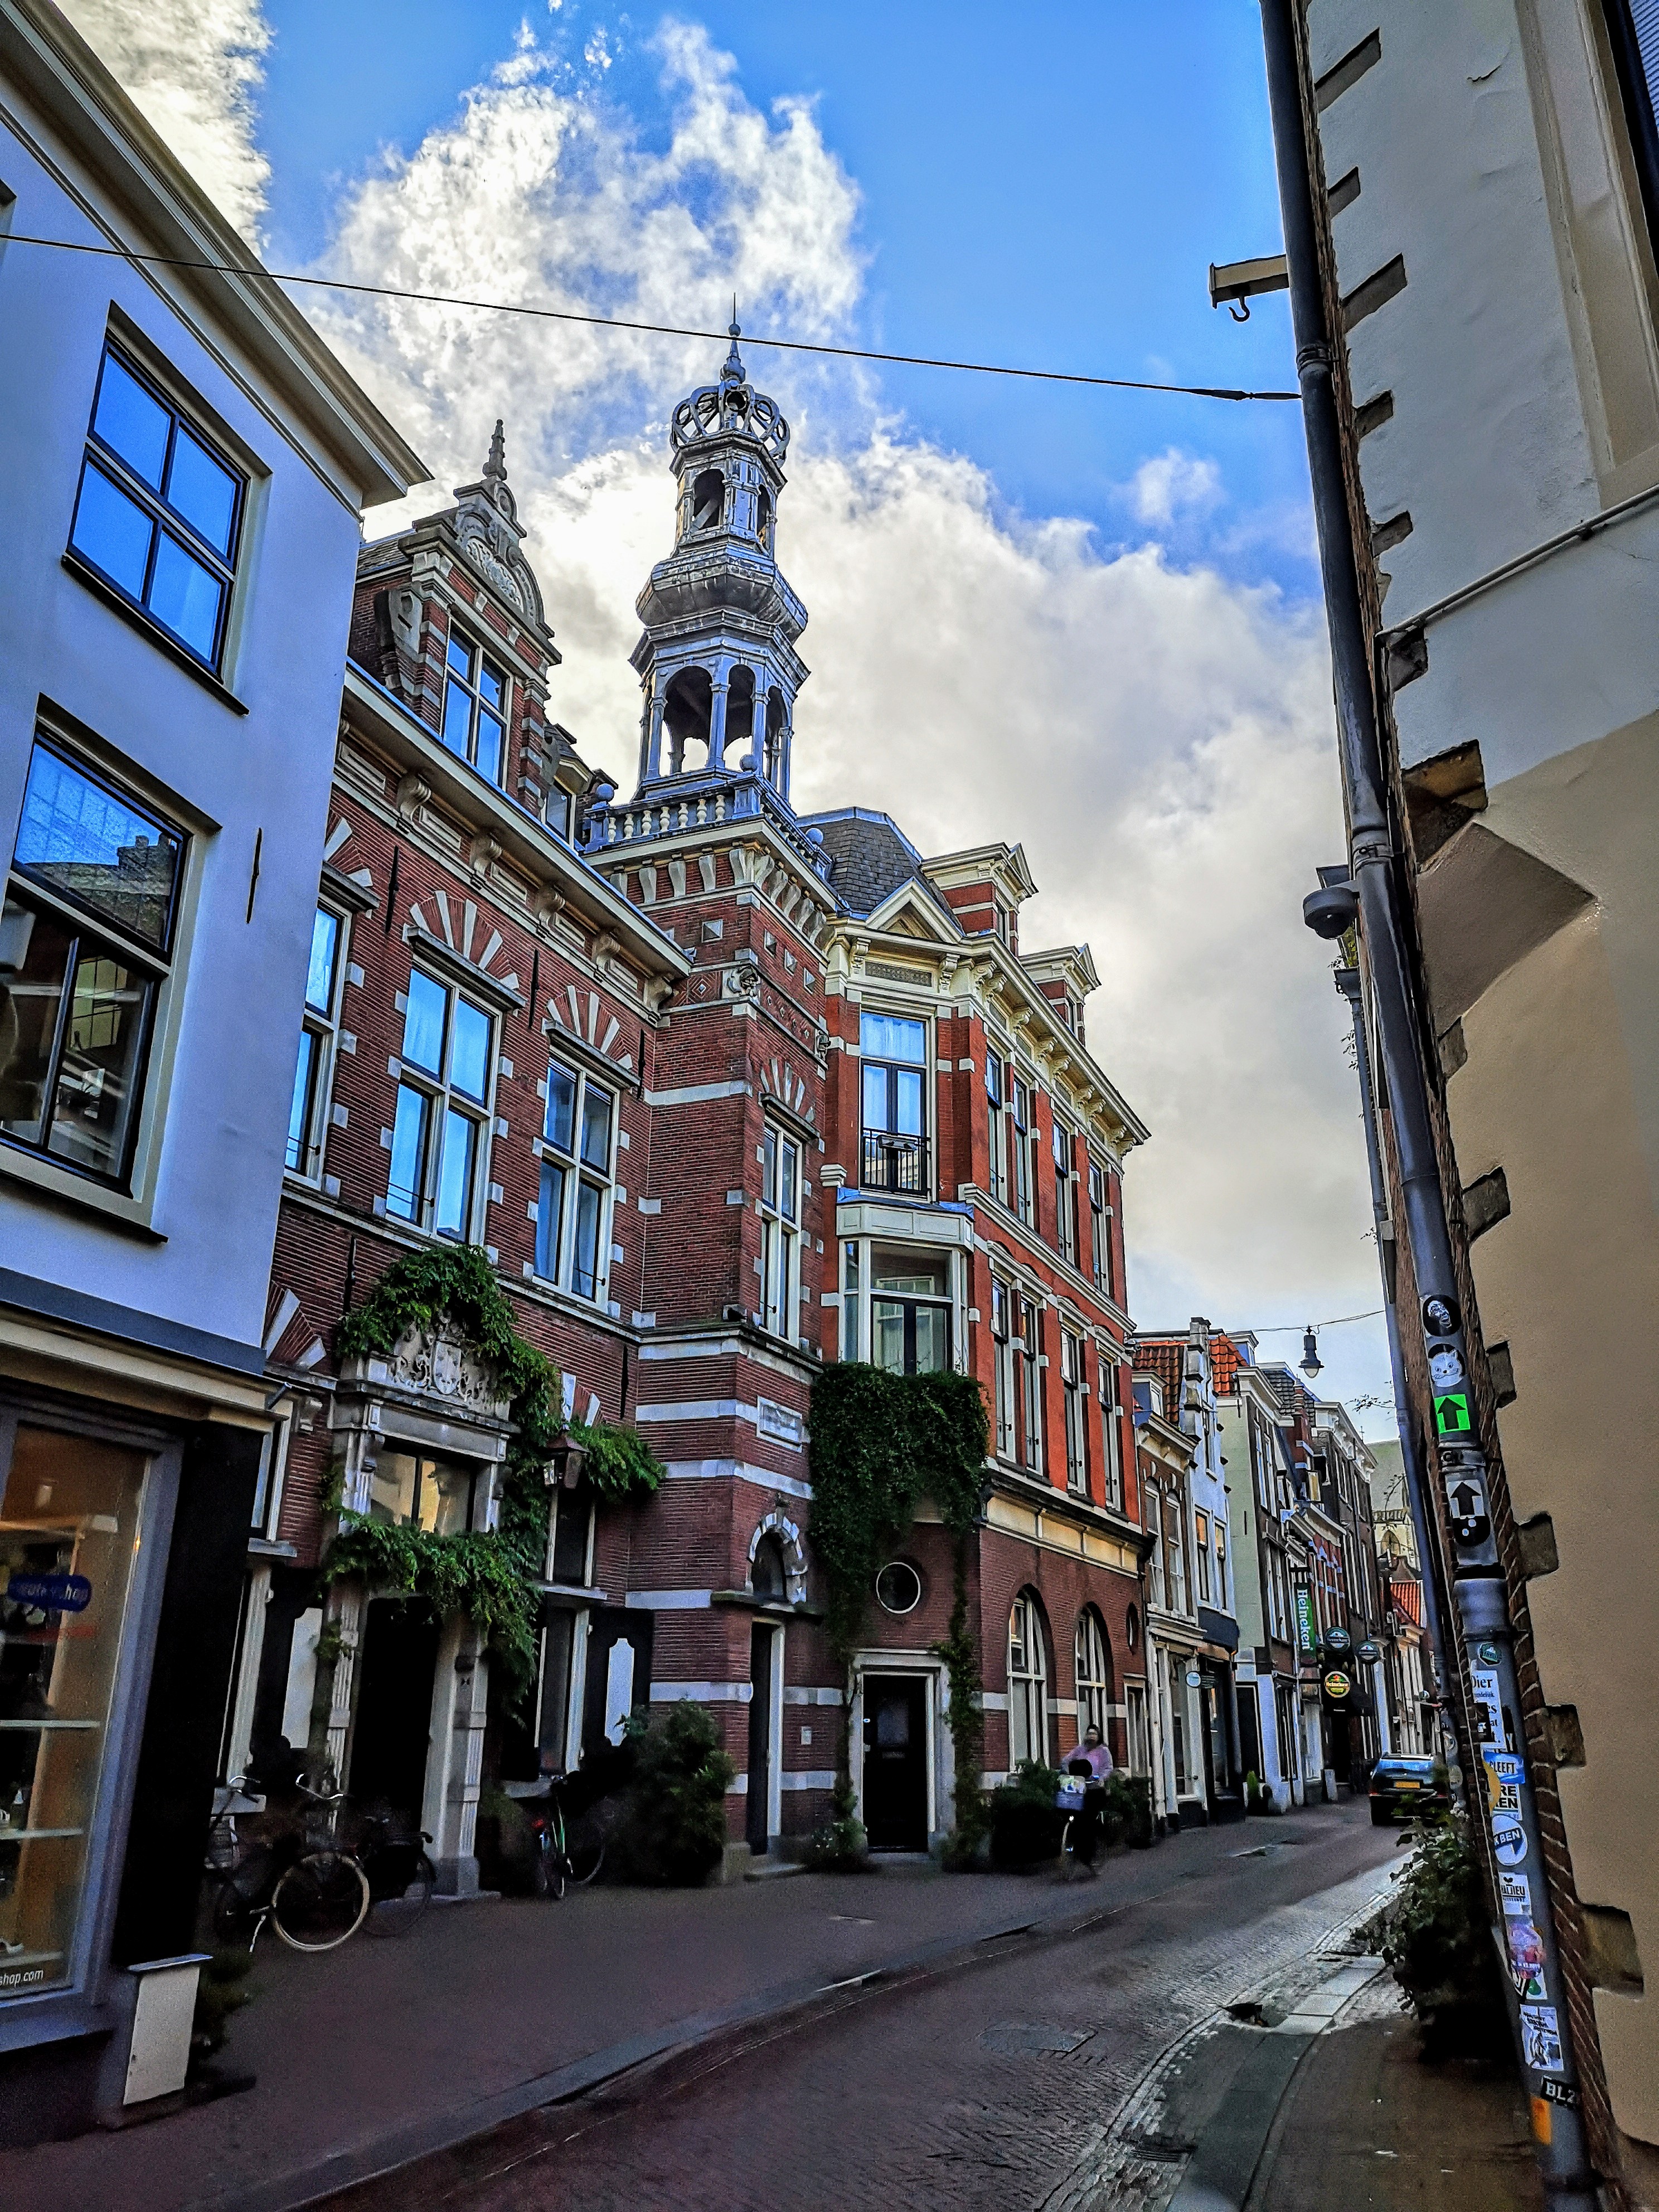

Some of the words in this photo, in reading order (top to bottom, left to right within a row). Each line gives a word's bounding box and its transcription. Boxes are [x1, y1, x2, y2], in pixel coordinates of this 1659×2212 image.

[1297, 1589, 1311, 1650] Heineken
[1496, 1797, 1518, 1808] EN
[1500, 1829, 1521, 1844] BEN
